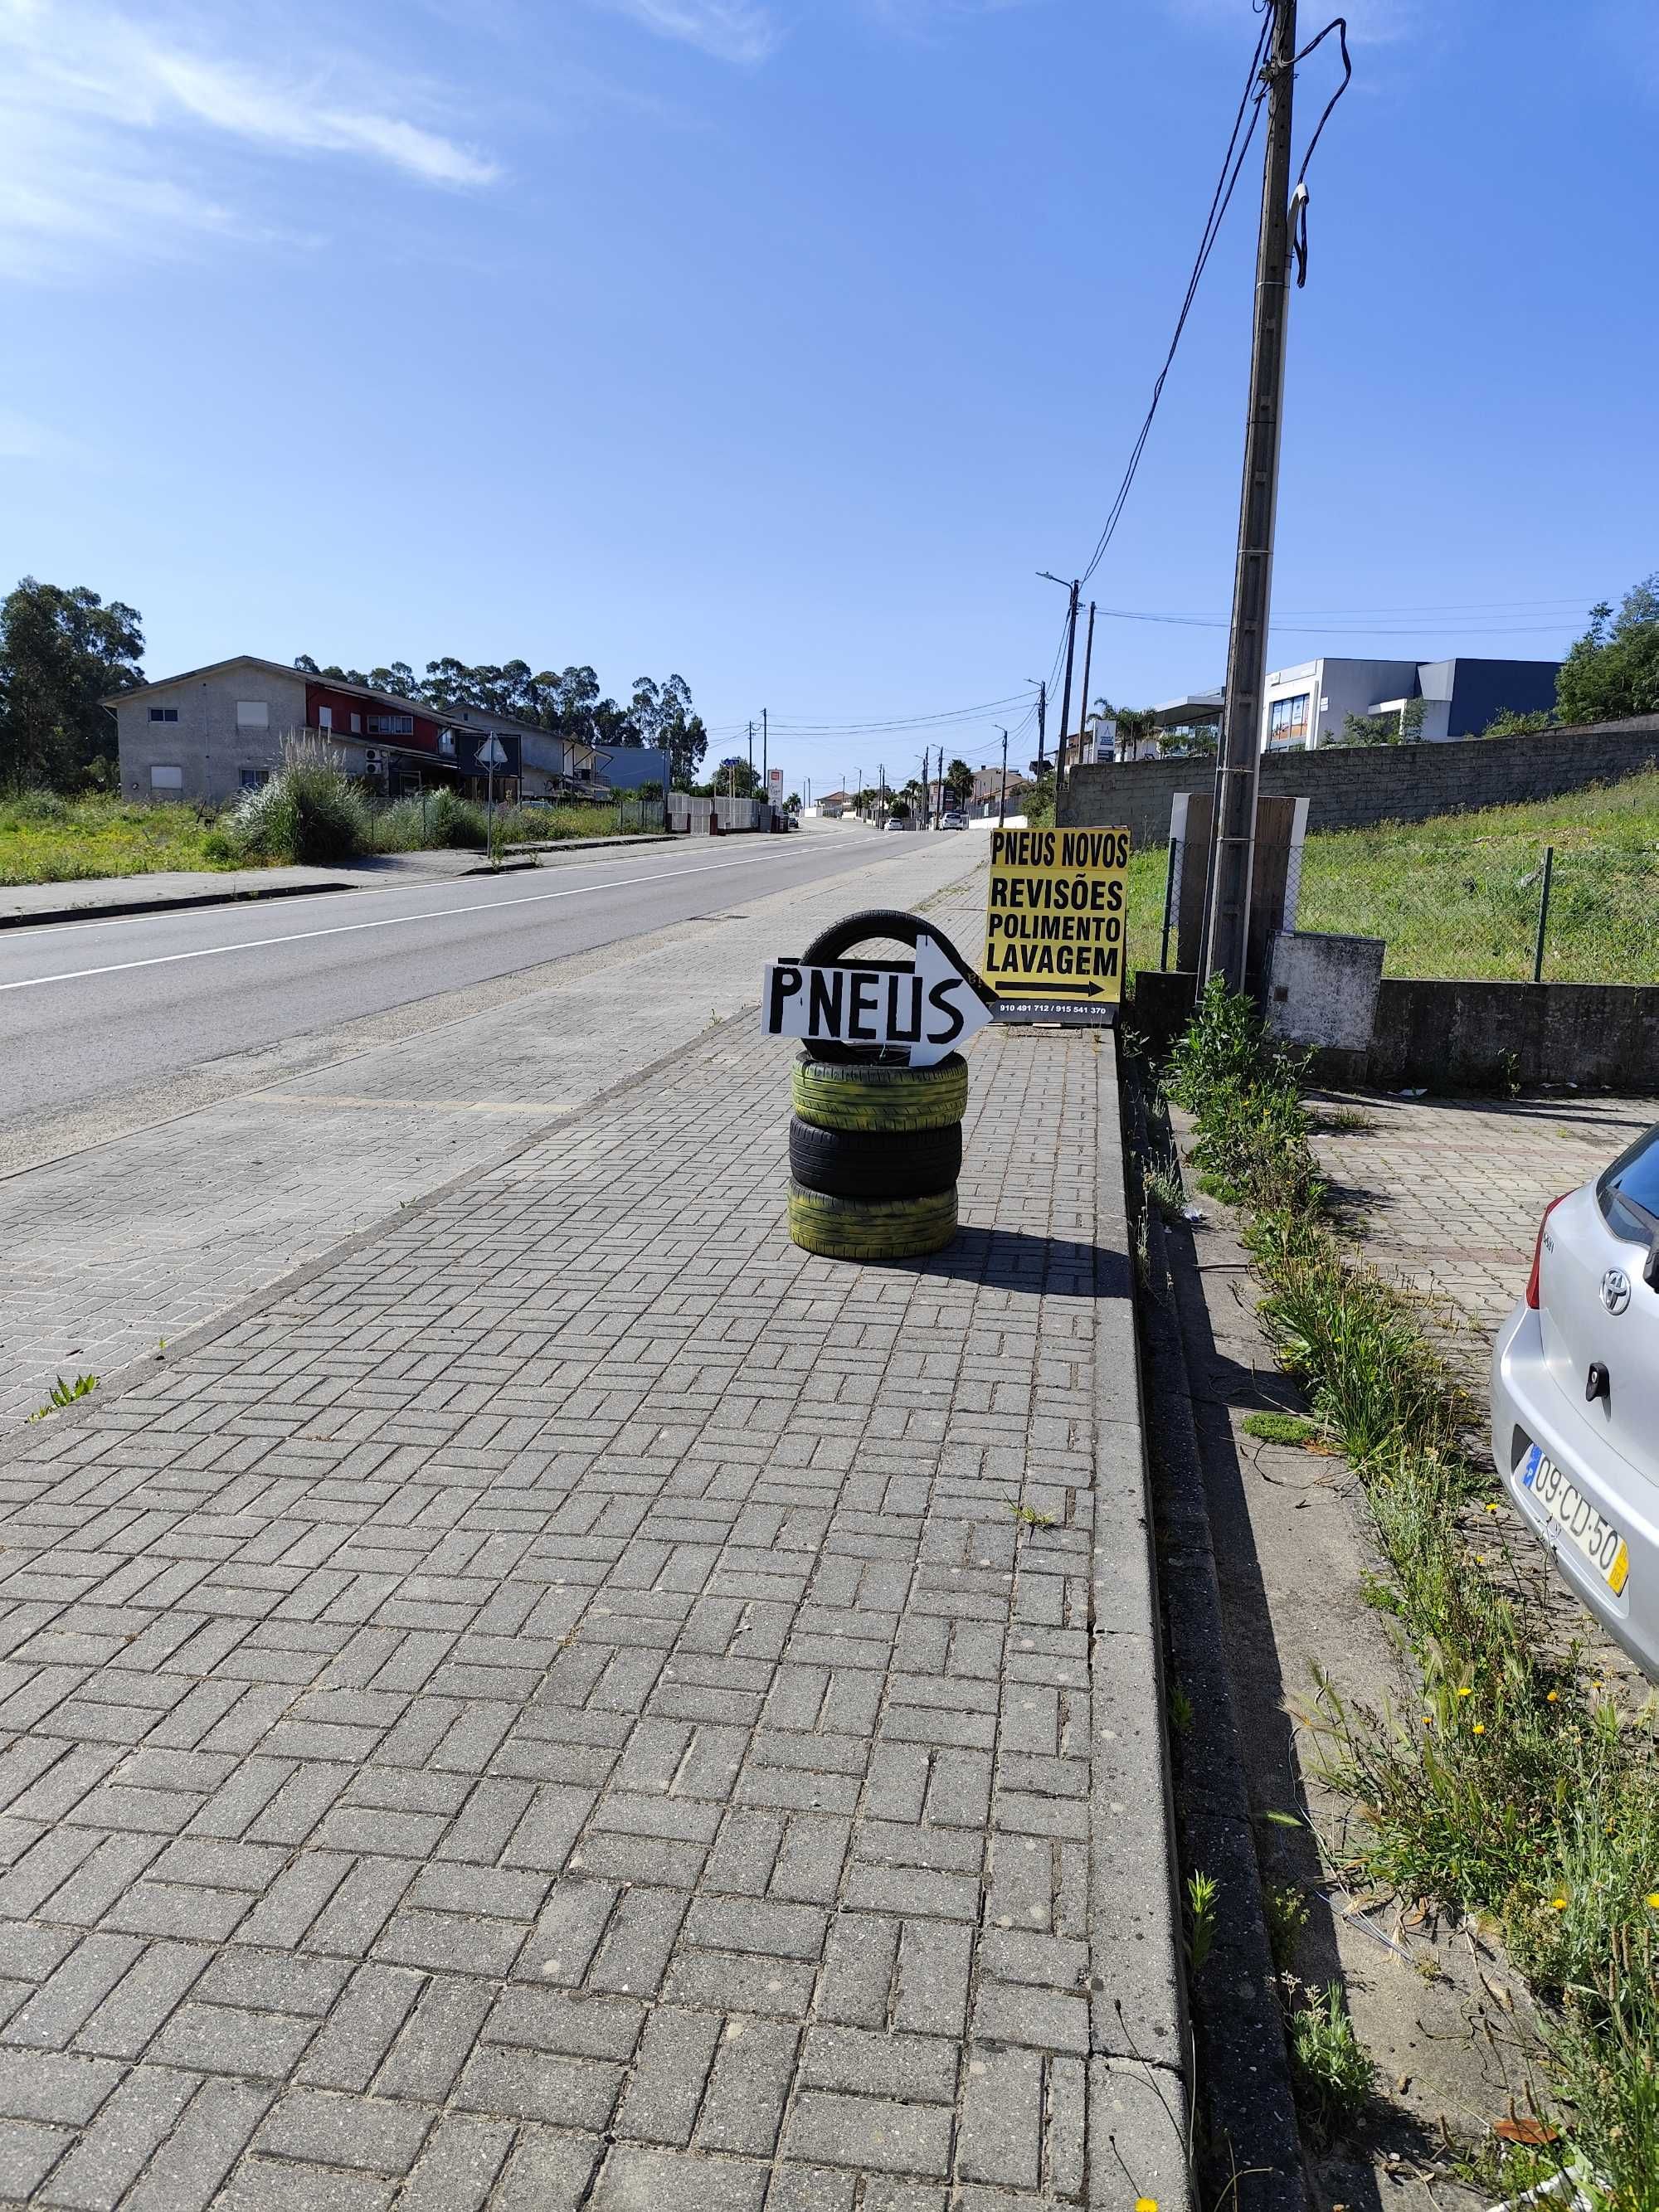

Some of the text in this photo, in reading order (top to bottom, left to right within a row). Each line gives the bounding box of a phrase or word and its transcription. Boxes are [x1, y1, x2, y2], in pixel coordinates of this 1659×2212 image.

[992, 832, 1128, 868] PNEUS NOVOS
[991, 873, 1123, 911] REVISÕES
[989, 913, 1121, 942] POLIMENTO
[986, 943, 1118, 976] LAVAGEM
[769, 966, 965, 1044] PNEUS
